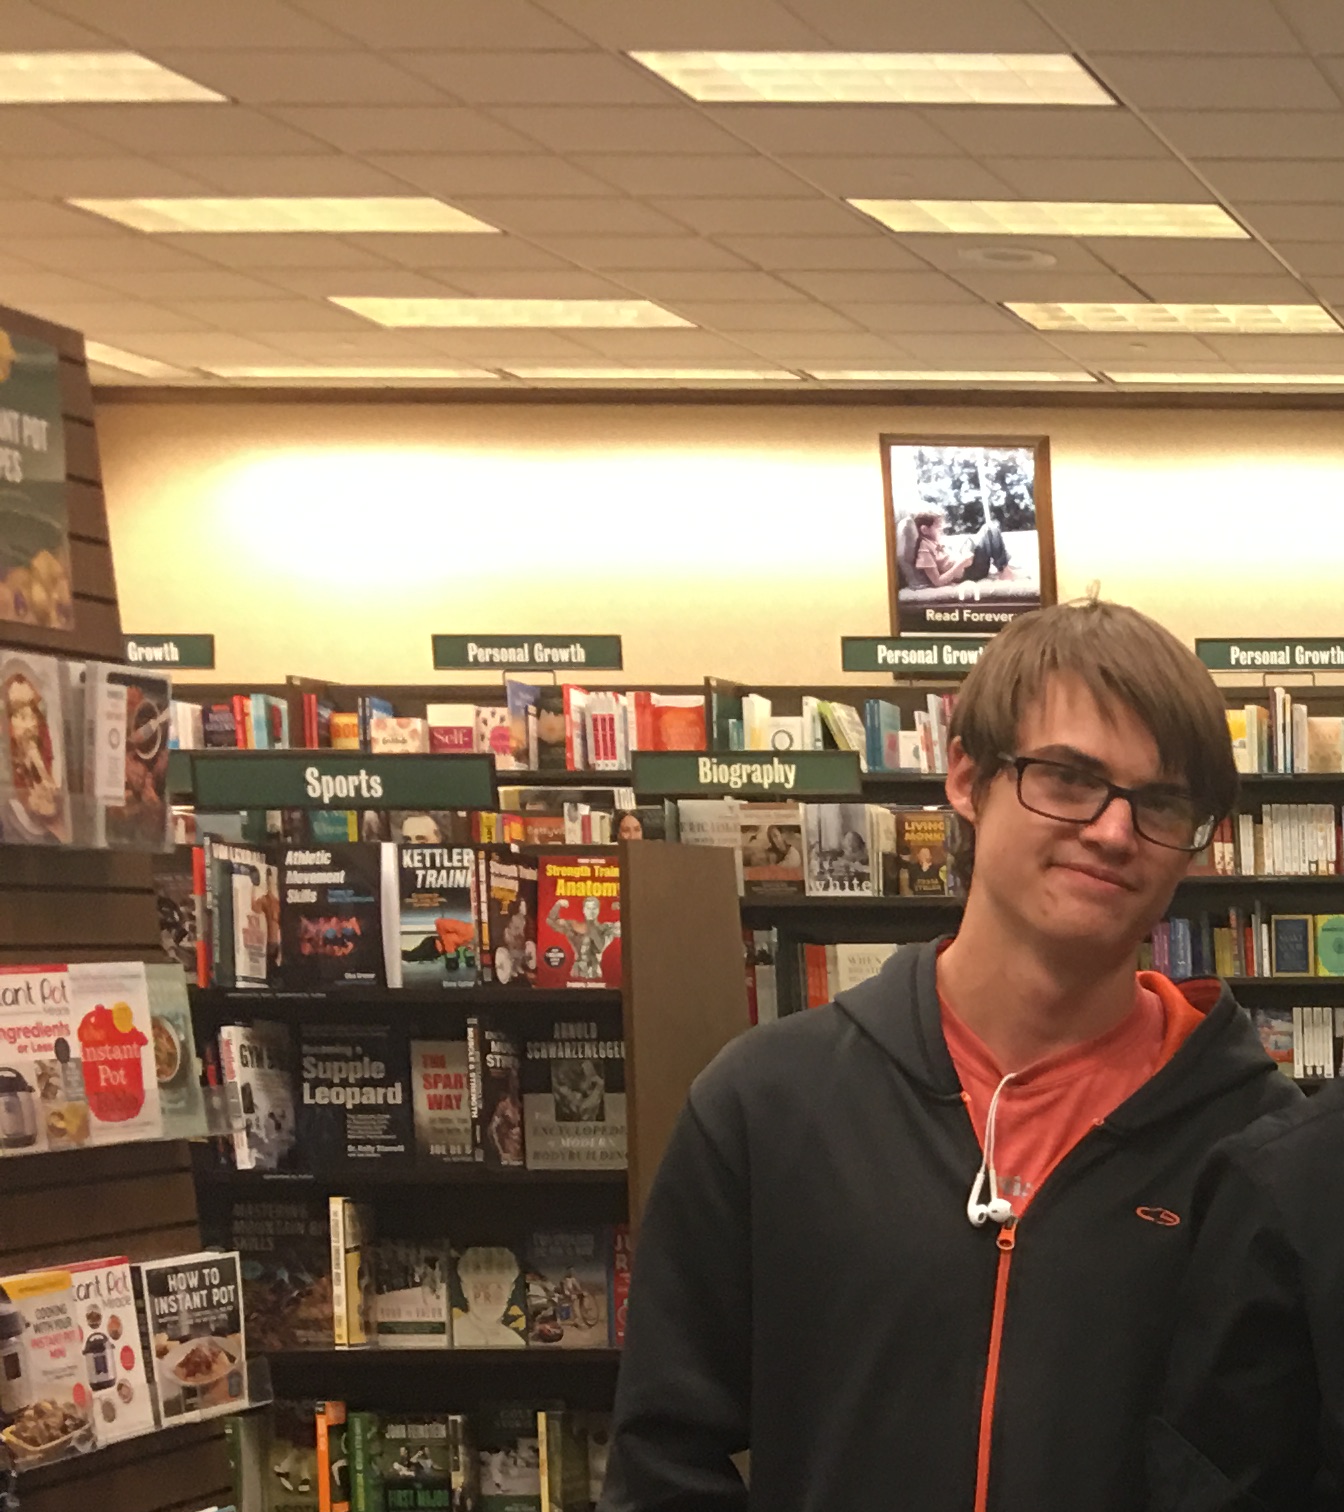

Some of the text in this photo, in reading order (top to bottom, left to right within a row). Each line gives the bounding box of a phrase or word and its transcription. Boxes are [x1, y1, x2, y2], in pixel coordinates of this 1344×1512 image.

[925, 609, 1014, 622] Read Forever
[126, 642, 180, 664] Growth
[467, 642, 586, 664] Personal Growth
[877, 644, 938, 665] Personal
[1229, 645, 1344, 665] Personal Growth
[698, 757, 796, 789] Biography
[304, 766, 384, 803] Sports
[284, 849, 332, 866] Athletic
[285, 869, 346, 885] Movement
[546, 864, 593, 878] Strength
[812, 875, 871, 893] white
[286, 888, 318, 904] Skills
[40, 977, 69, 1005] Pot
[553, 1021, 598, 1039] ARNOLD
[98, 1064, 128, 1087] Pot
[302, 1056, 387, 1083] Supple
[302, 1082, 404, 1110] Leopard
[427, 1094, 463, 1111] WAY
[469, 1071, 478, 1119] STRENGTH
[106, 1270, 130, 1296] Pot
[167, 1266, 221, 1293] HOW TO
[154, 1285, 236, 1317] INSTANT POT
